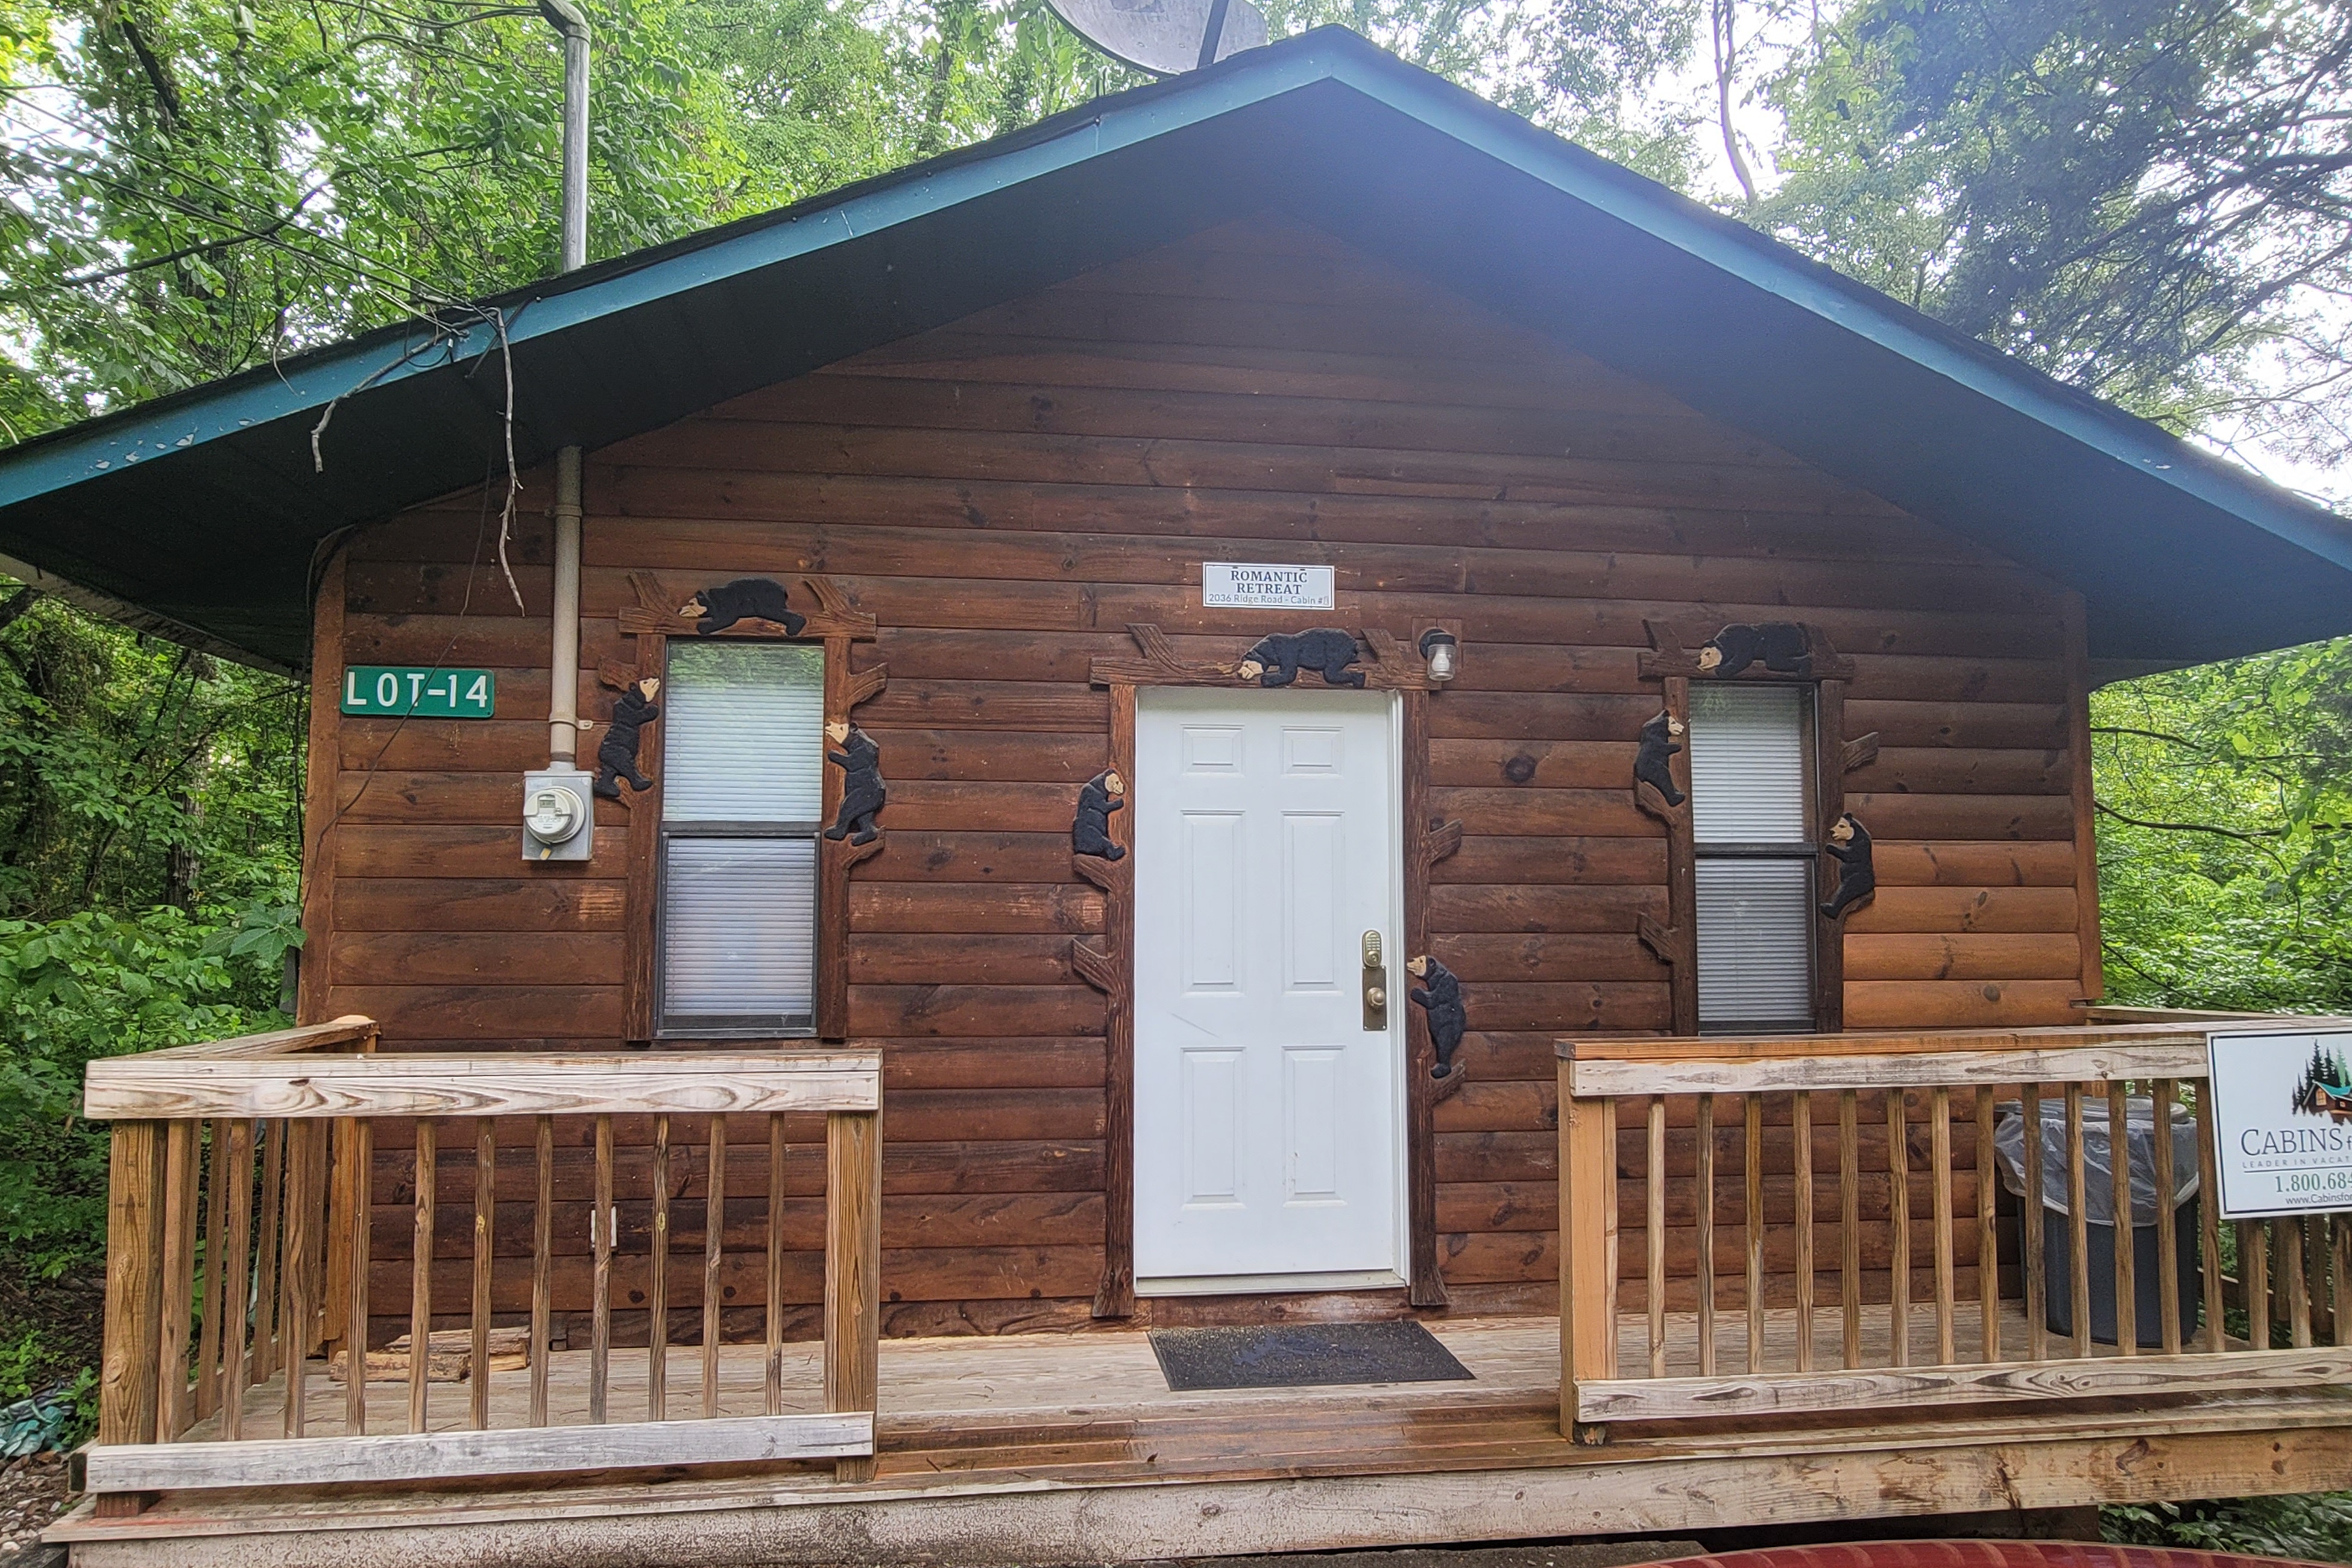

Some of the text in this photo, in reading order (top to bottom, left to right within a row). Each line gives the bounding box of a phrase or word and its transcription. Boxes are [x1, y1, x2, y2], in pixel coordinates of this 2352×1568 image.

[1231, 570, 1308, 583] ROMANTIC
[1237, 583, 1302, 594] RETREAT
[1209, 594, 1231, 602] 2036
[1234, 594, 1259, 605] Ridge
[1261, 595, 1283, 603] Road
[1290, 596, 1316, 604] Cabin
[347, 672, 488, 708] LOT-14
[2240, 1127, 2343, 1156] CABINS
[2242, 1159, 2288, 1168] LEADER
[2312, 1156, 2350, 1165] VACAT
